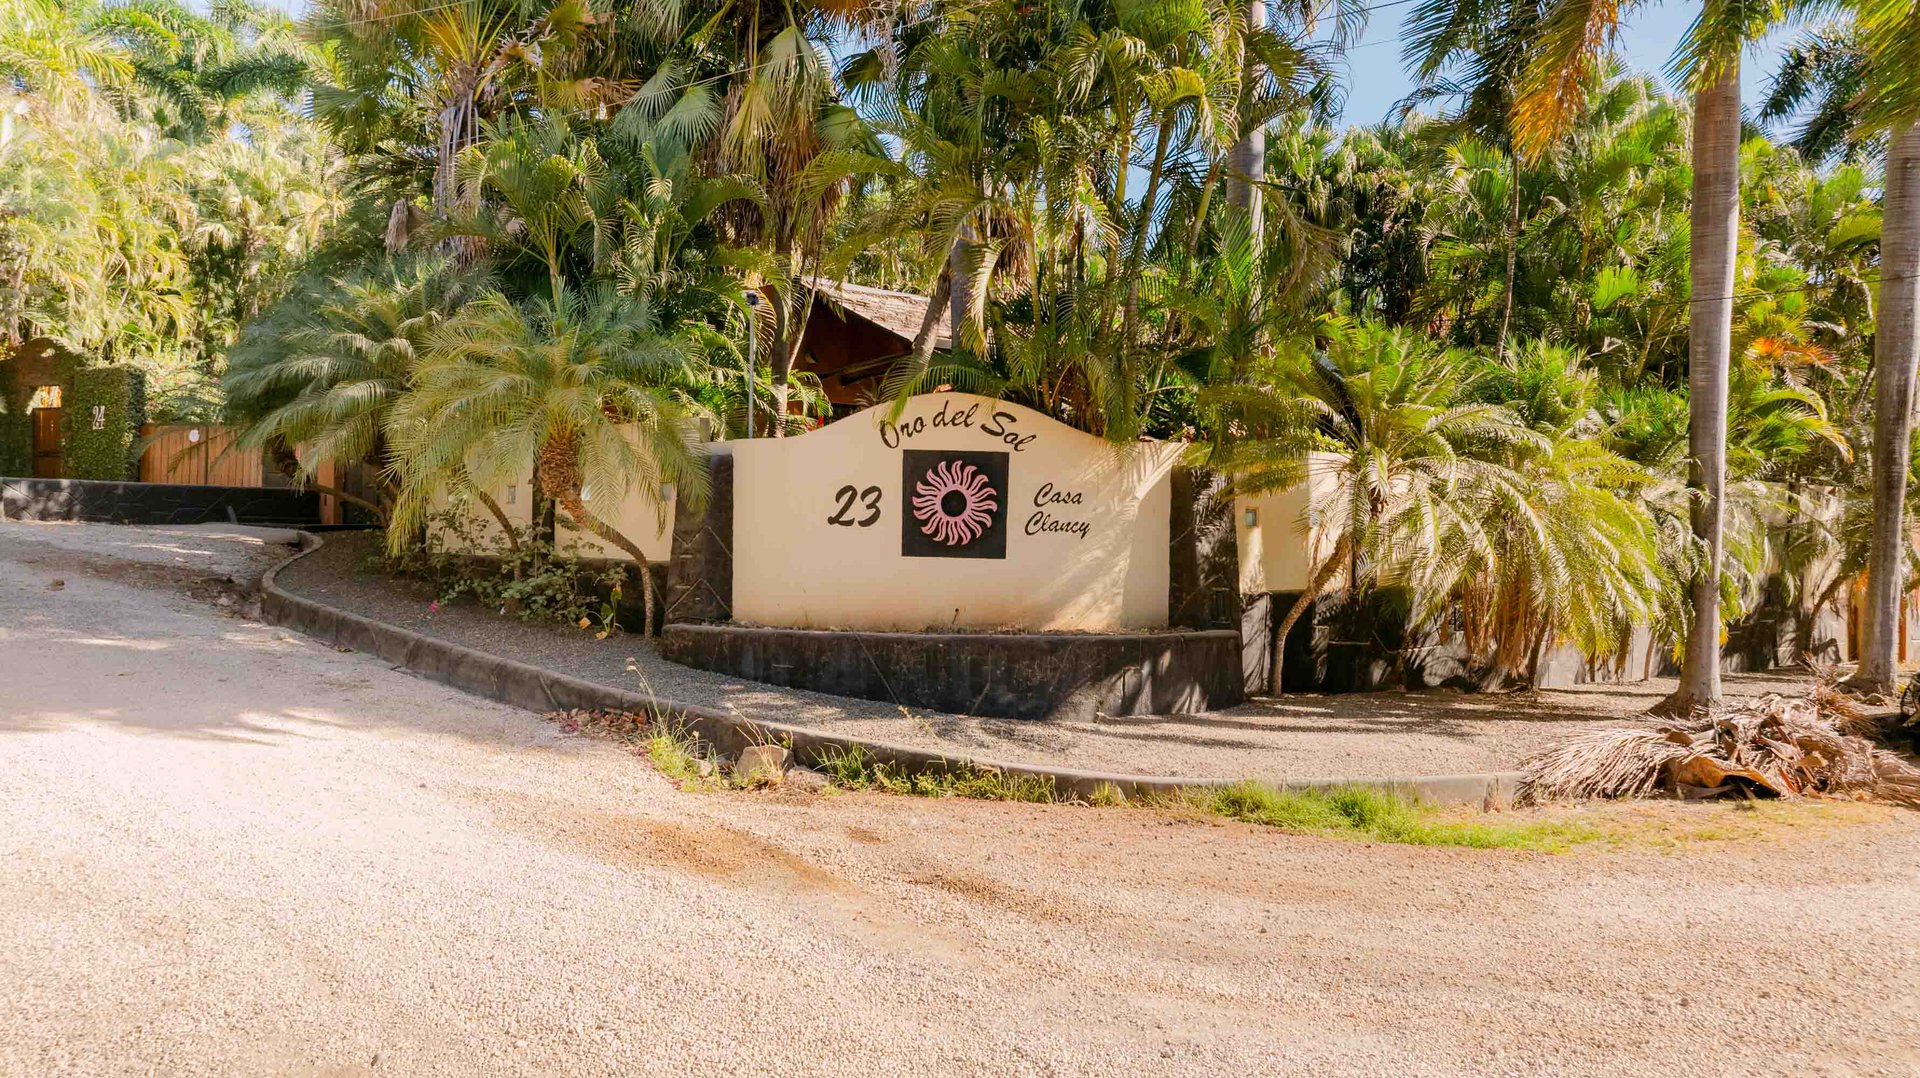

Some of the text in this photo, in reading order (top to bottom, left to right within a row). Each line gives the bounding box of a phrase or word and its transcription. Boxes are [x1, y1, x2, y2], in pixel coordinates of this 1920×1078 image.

[92, 405, 106, 430] 24
[879, 400, 1037, 452] Oro del Sol
[827, 484, 883, 528] 23
[1033, 482, 1083, 507] Casa
[1024, 511, 1091, 540] Clancy
